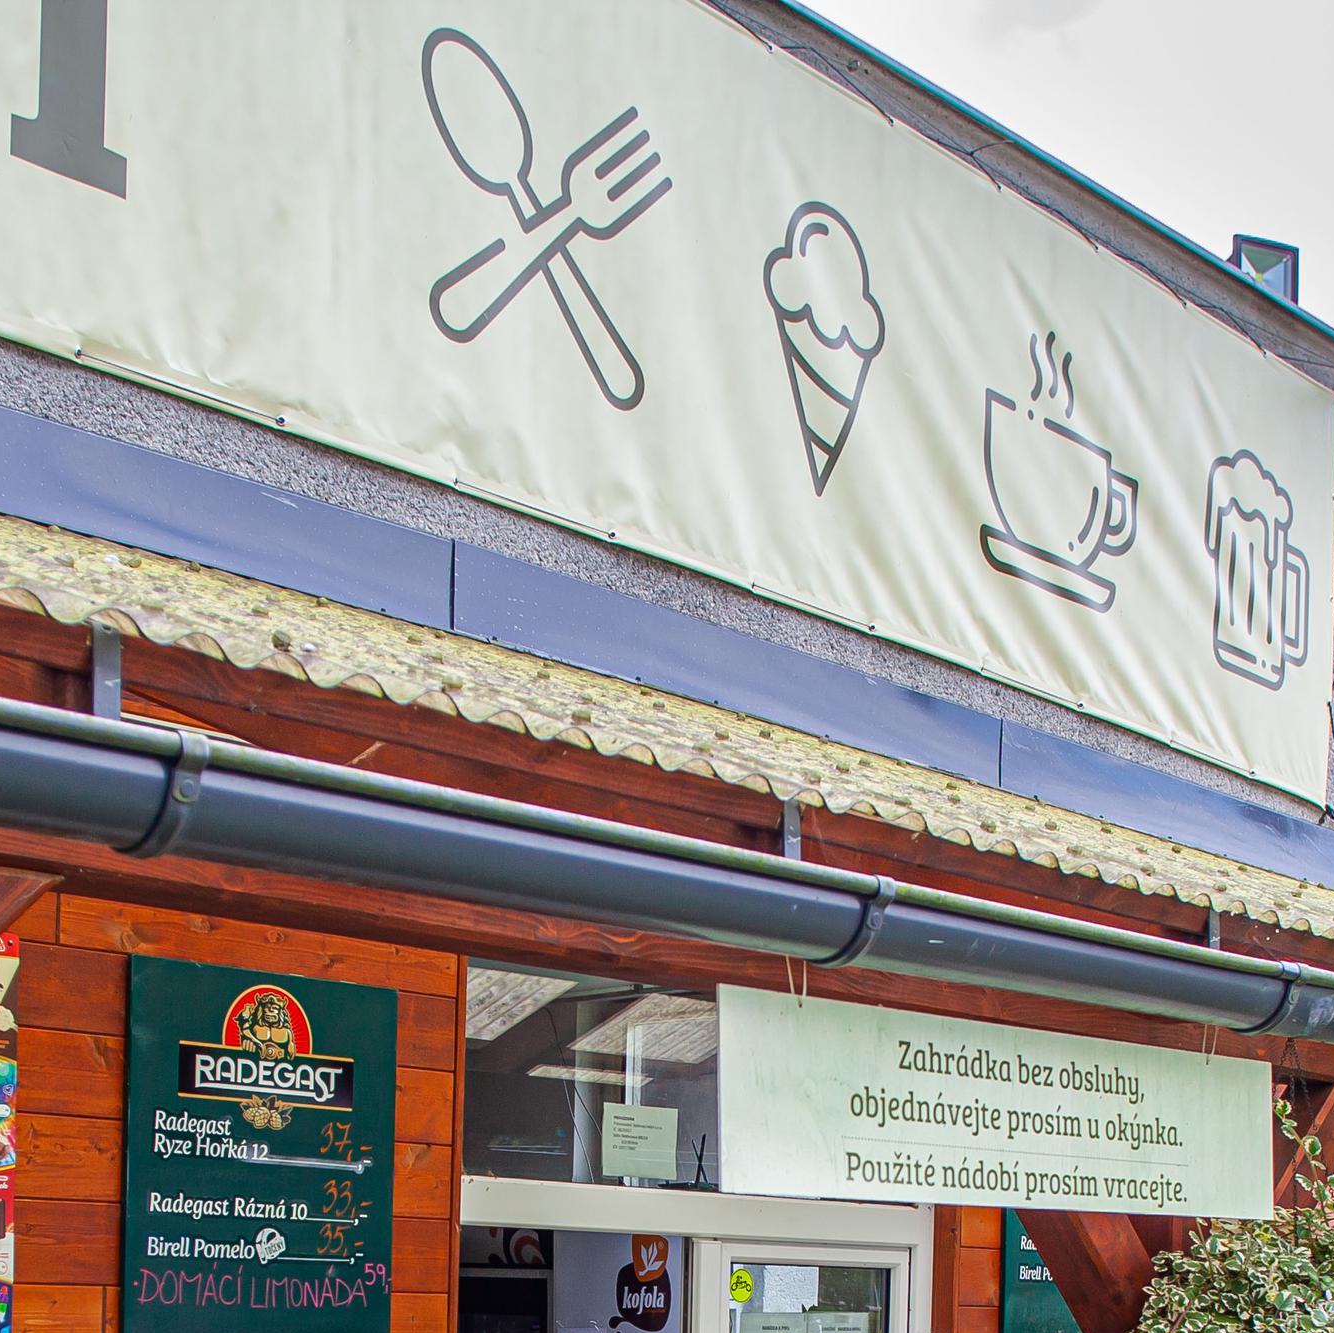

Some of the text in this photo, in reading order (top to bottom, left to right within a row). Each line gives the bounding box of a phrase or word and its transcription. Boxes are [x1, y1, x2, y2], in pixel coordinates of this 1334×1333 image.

[195, 1054, 342, 1102] RADEGAST
[897, 1040, 1146, 1105] Zahrádka bez obsluhy,
[155, 1110, 231, 1137] Radegast
[850, 1087, 1184, 1151] objednávejte prosím u okýnka.
[154, 1134, 268, 1160] Ryze Hořká 12
[845, 1149, 1188, 1207] Použité nádobí prosím vracejte.
[149, 1193, 307, 1220] Radegast Rázná 10
[147, 1237, 255, 1259] Birell Pomelo
[138, 1262, 243, 1306] DOMÁCÍ
[250, 1265, 367, 1308] LIMONÁDA
[1019, 1265, 1042, 1280] Birell
[622, 1286, 665, 1315] kofola
